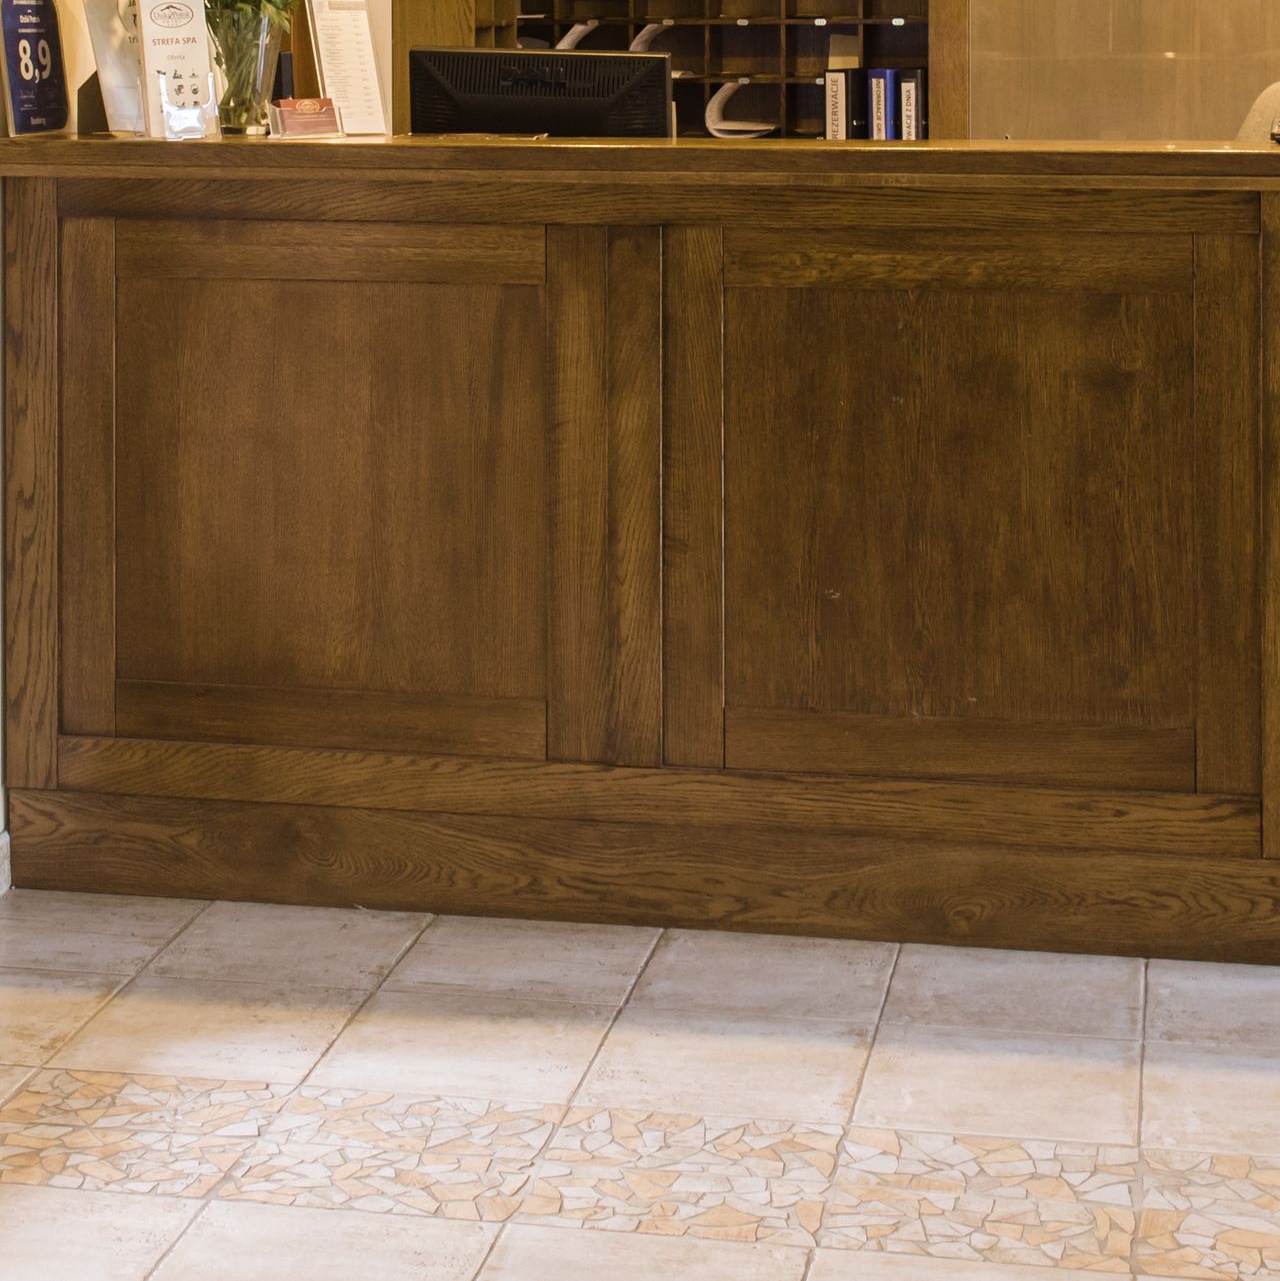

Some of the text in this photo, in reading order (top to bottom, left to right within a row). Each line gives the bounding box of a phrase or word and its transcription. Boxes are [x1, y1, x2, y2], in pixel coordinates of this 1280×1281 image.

[152, 36, 198, 47] STREFA SPA
[18, 39, 52, 85] 8,9
[166, 53, 186, 62] Oferta
[830, 77, 840, 140] REZERWACJE
[905, 113, 913, 139] WACJE
